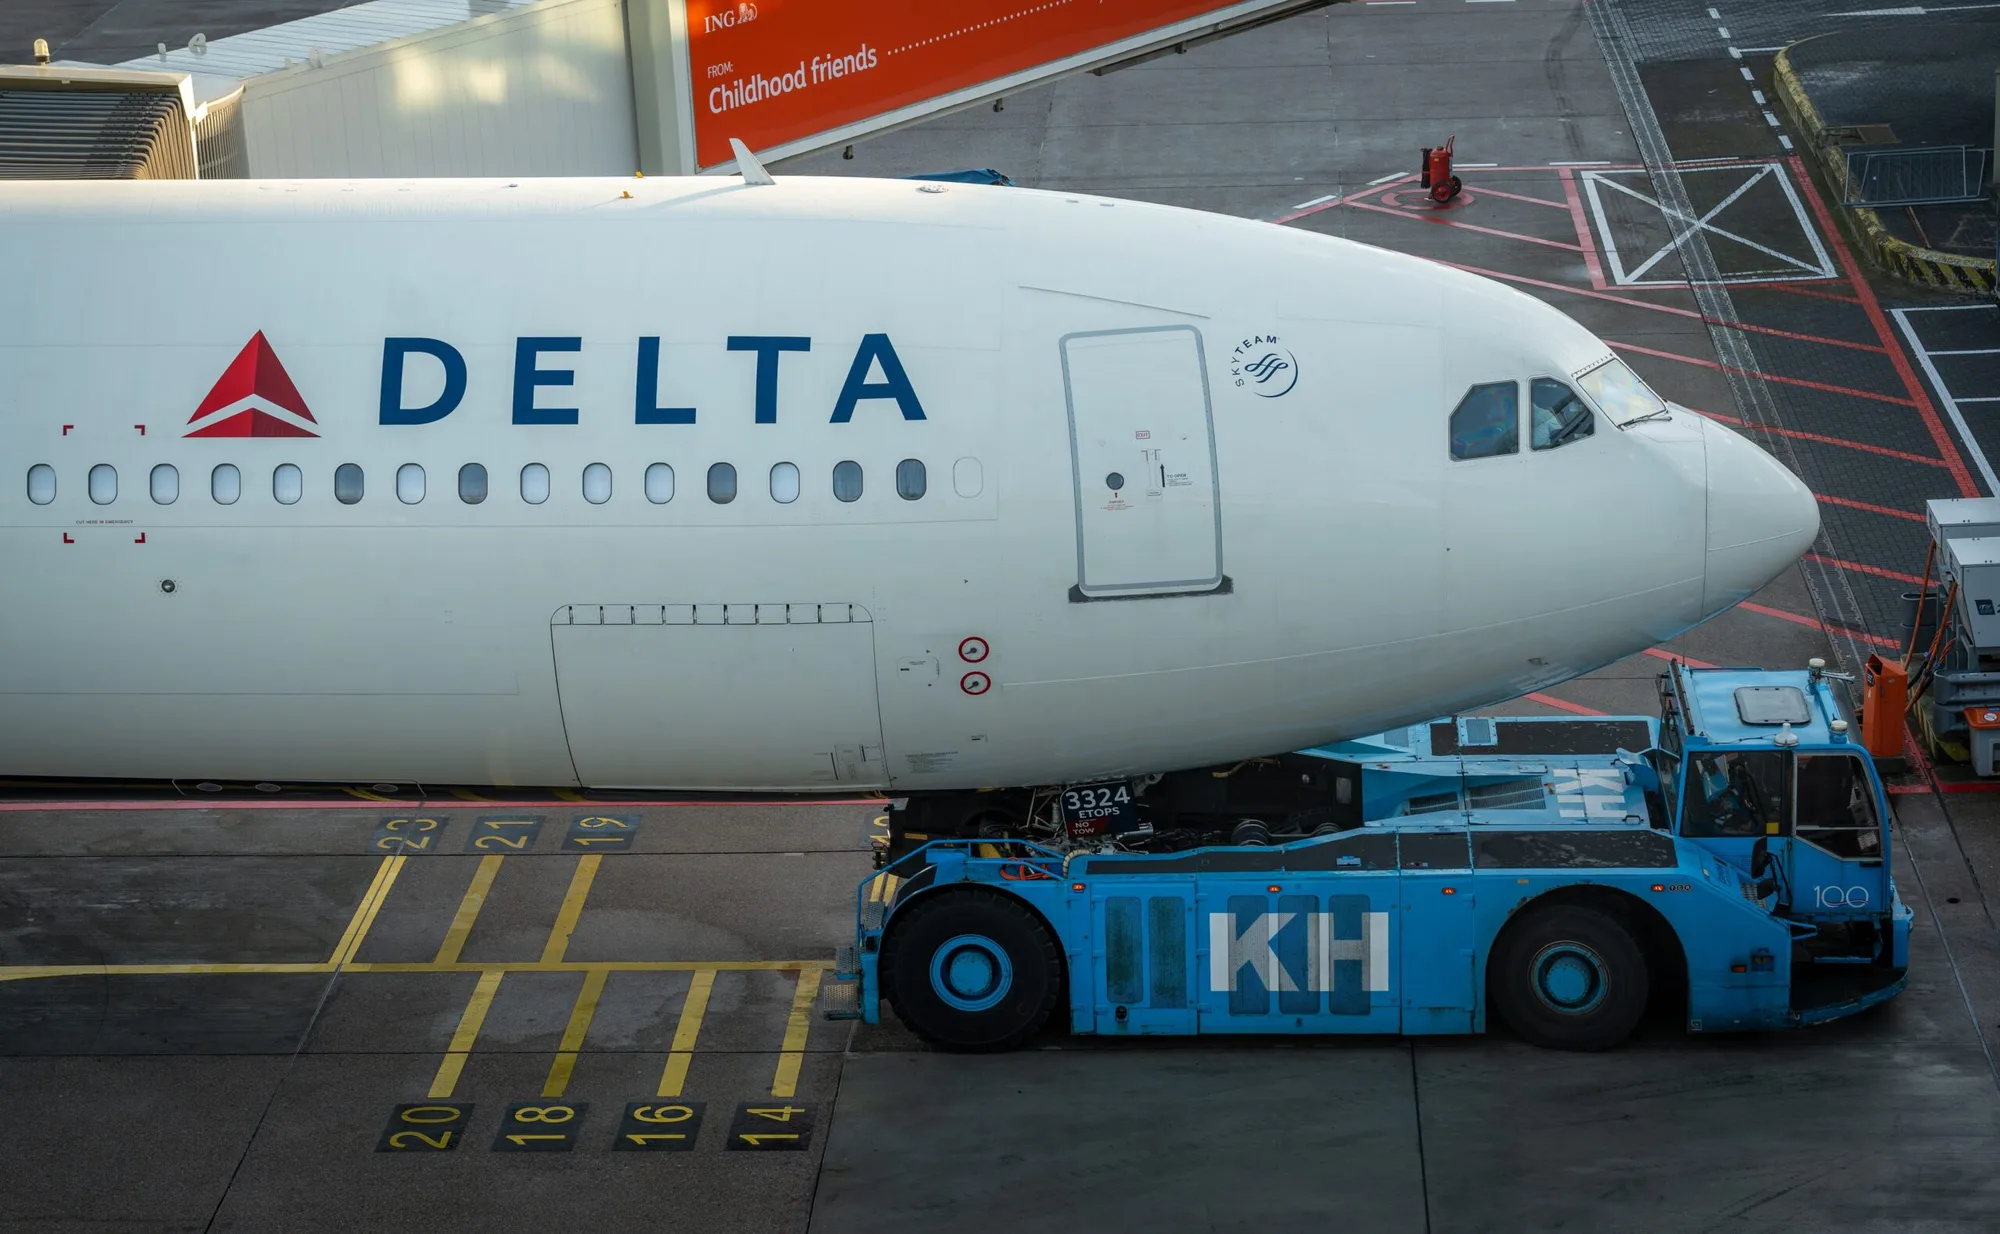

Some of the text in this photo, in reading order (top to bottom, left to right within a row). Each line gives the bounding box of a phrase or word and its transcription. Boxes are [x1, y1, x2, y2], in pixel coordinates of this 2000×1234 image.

[704, 10, 736, 34] ING
[707, 61, 734, 79] FROM:
[708, 43, 878, 114] Childhood friends
[1231, 335, 1278, 388] SKYTEAM
[379, 333, 928, 426] DELTA
[1065, 786, 1130, 810] 3324
[1078, 806, 1120, 819] ETOPS
[475, 820, 534, 849] 21
[573, 816, 629, 846] 19
[1072, 827, 1095, 835] TOW
[1075, 821, 1090, 829] NO
[1813, 885, 1870, 909] 100
[1209, 912, 1389, 992] KH
[389, 1105, 461, 1149] 20
[506, 1105, 575, 1146] 18
[626, 1105, 694, 1146] 16
[739, 1105, 806, 1146] 14
